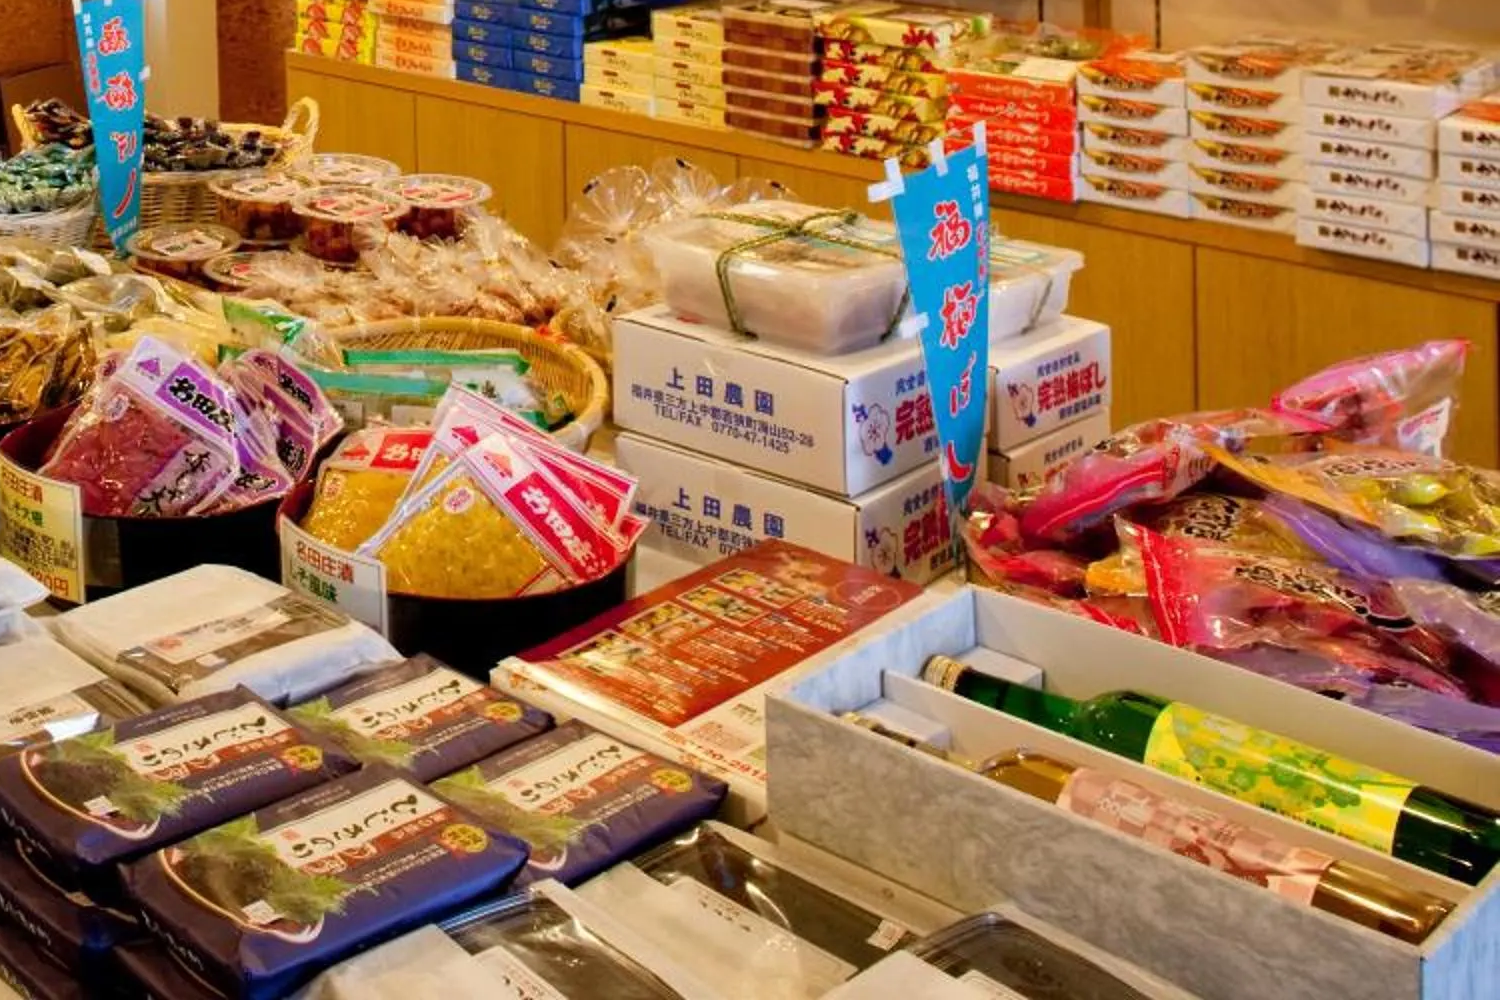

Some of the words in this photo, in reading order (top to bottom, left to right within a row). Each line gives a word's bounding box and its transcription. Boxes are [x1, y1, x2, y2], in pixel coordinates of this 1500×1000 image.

[666, 366, 774, 416] 上田農園
[1038, 360, 1106, 414] 完熟梅ぼし
[672, 487, 785, 538] 上田農園
